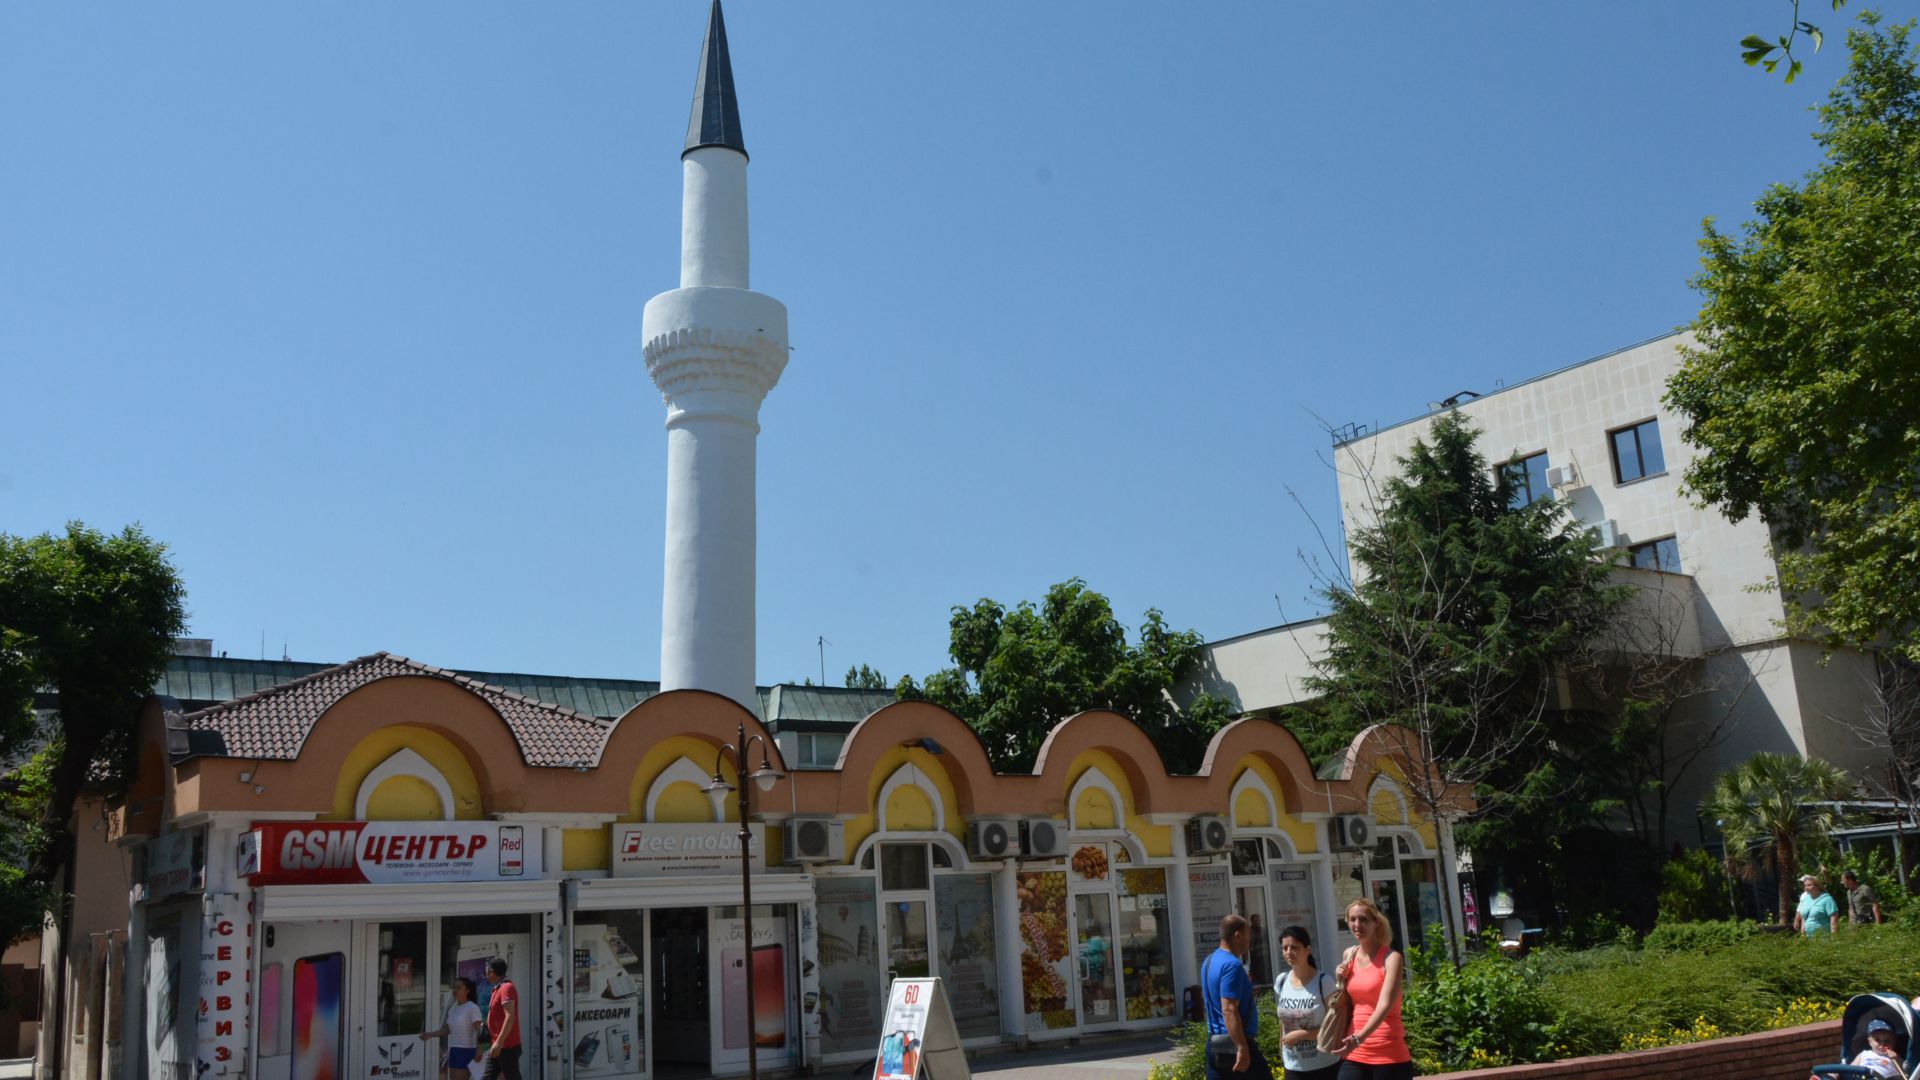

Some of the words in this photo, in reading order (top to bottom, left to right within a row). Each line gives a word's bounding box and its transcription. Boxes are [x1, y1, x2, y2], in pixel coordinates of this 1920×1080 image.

[501, 837, 521, 851] Red
[621, 830, 676, 853] Free
[280, 829, 357, 870] GSM
[363, 834, 487, 865] ЦЕНТЪР
[386, 862, 415, 870] ТЕЛЕФОНИ
[1201, 872, 1226, 881] ASSET
[1140, 897, 1168, 908] КАФЕ
[215, 920, 234, 1062] СЕРВИЗ
[904, 984, 920, 1004] 6D
[575, 1007, 631, 1022] АКСЕСОАРИ
[370, 1065, 398, 1077] Free
[392, 1069, 420, 1079] mobile
